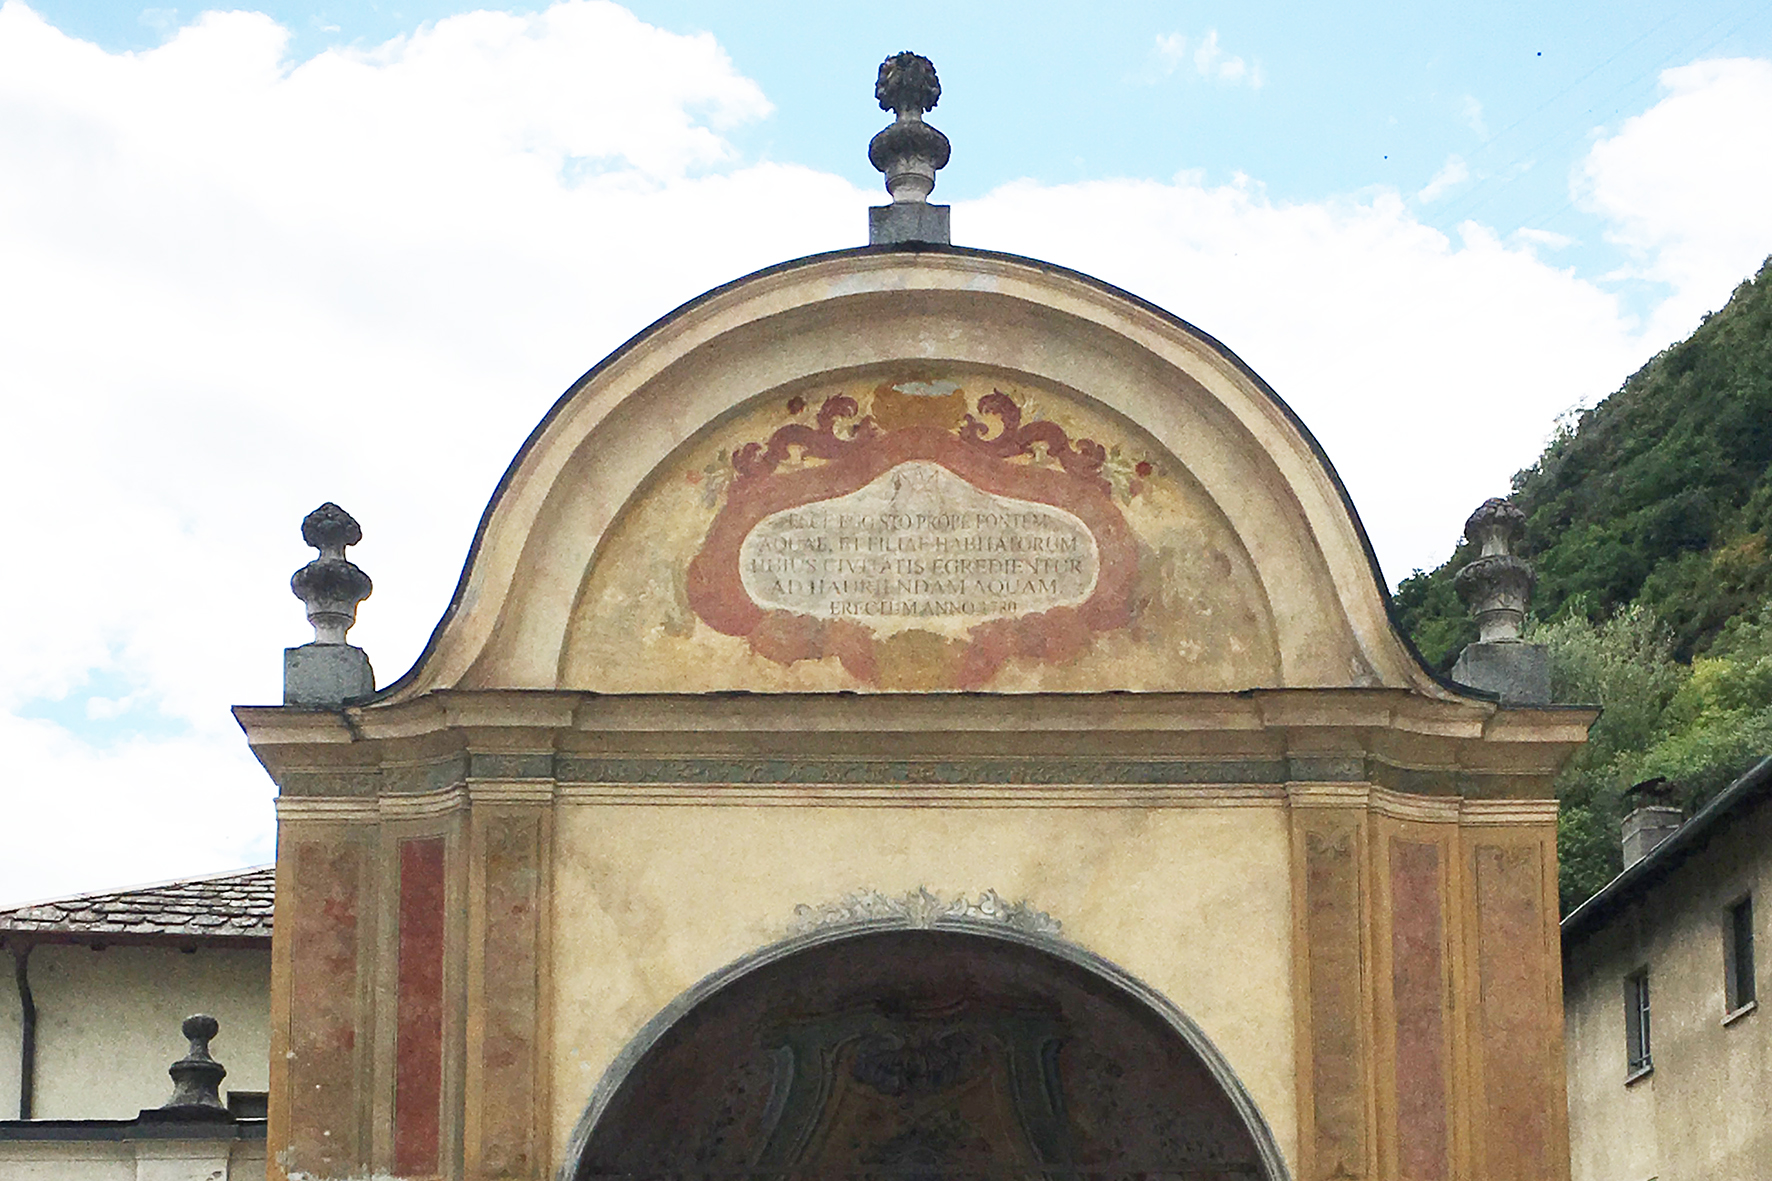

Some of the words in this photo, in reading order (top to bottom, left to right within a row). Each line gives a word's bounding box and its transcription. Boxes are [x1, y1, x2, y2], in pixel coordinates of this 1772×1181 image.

[880, 513, 912, 530] STO
[916, 512, 970, 531] PROPE
[919, 601, 975, 616] ANNO
